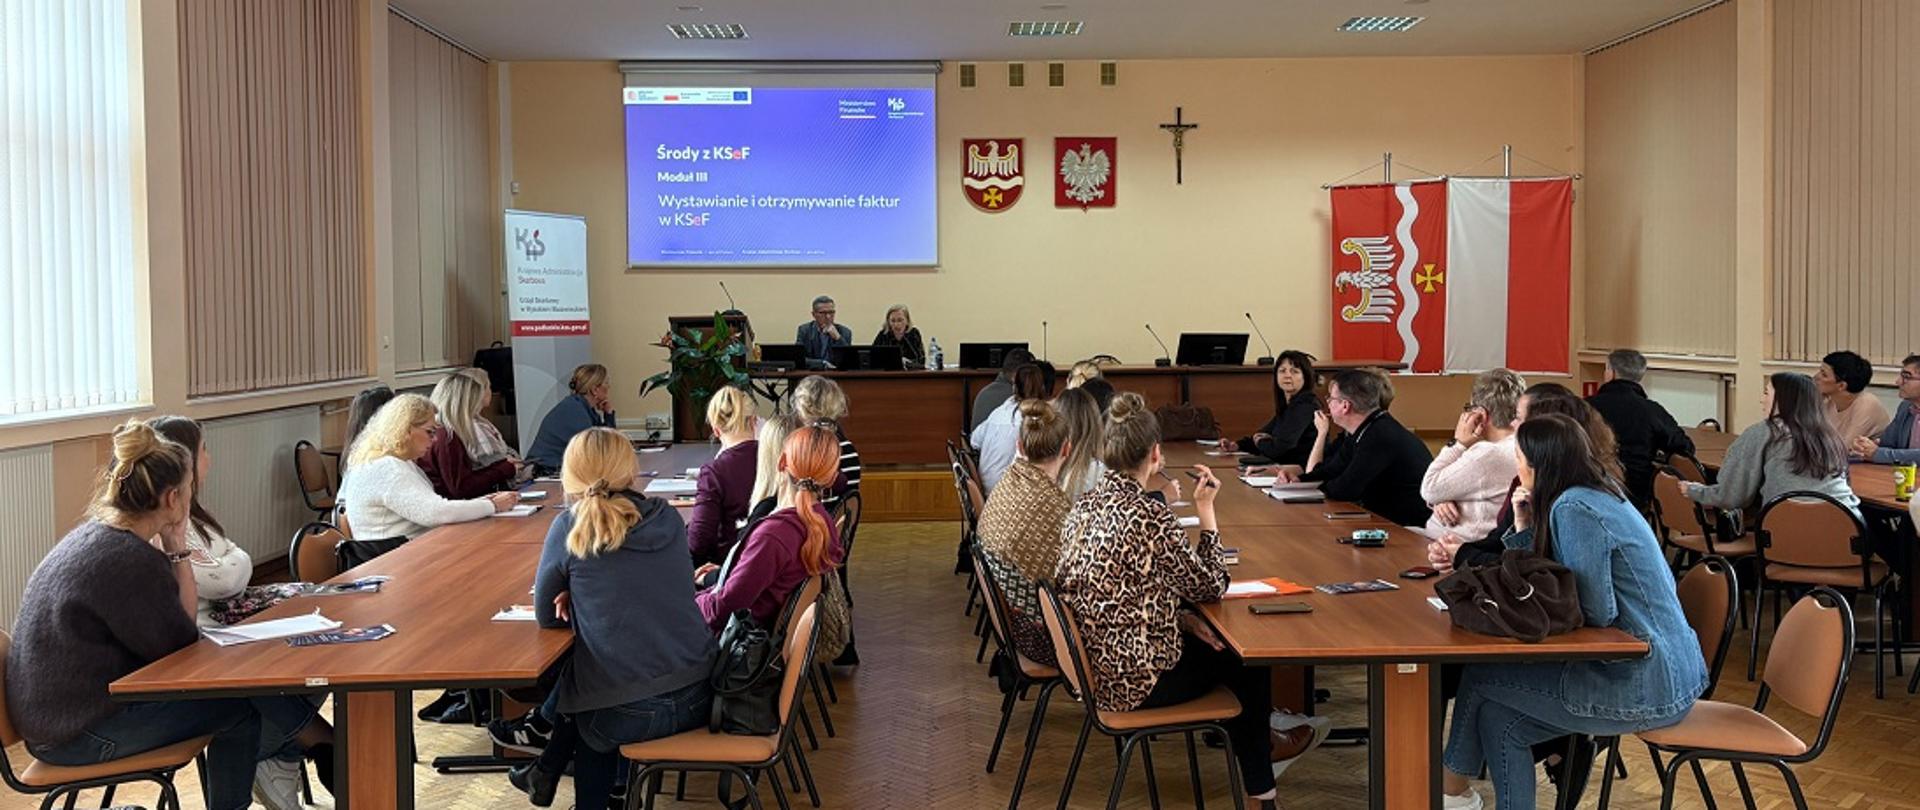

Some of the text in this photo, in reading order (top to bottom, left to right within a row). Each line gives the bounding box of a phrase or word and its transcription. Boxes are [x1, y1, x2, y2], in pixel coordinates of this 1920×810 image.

[657, 144, 751, 163] Środy z KSeF
[657, 171, 708, 182] Moduł III
[658, 194, 901, 211] Wystawianie i otrzymywanie faktur
[659, 212, 711, 227] w KSeF
